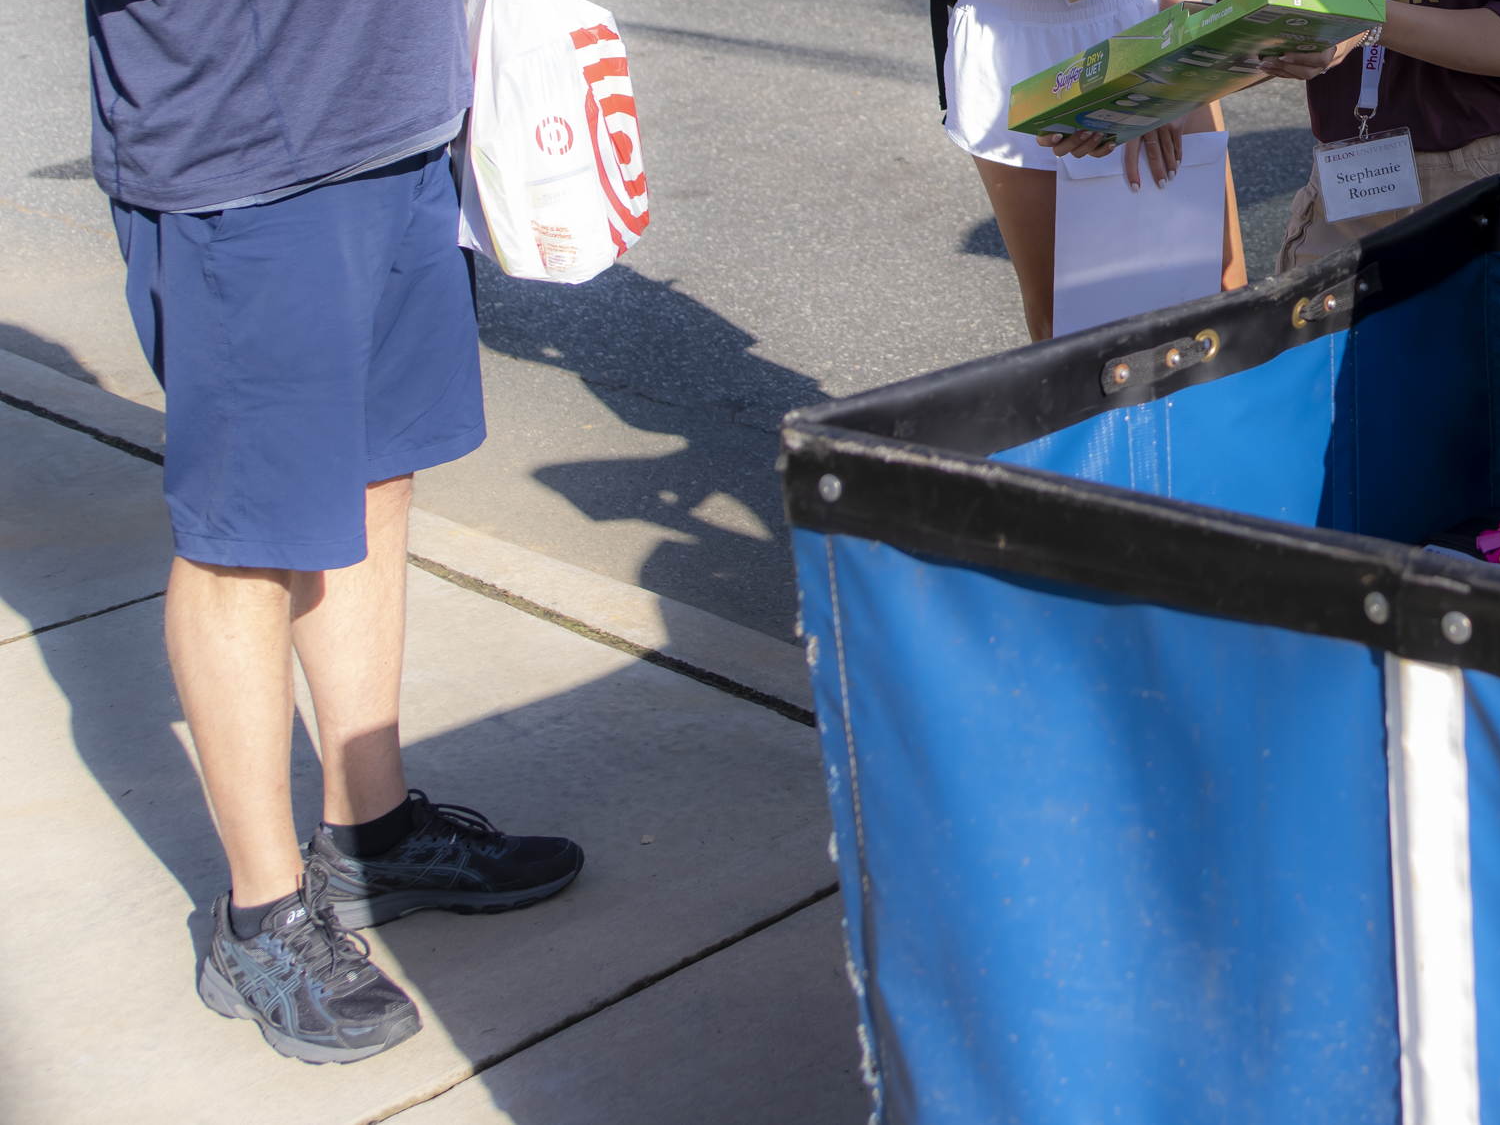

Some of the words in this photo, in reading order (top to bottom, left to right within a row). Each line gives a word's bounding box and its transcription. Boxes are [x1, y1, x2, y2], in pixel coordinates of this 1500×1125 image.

[1201, 5, 1234, 28] swiffer.com
[1052, 65, 1084, 94] Swiffer
[1085, 61, 1102, 78] WET
[1333, 151, 1355, 162] ELON
[1356, 140, 1408, 156] UNIVERSITY
[1336, 162, 1402, 184] Stephanie
[1348, 183, 1396, 200] Romeo
